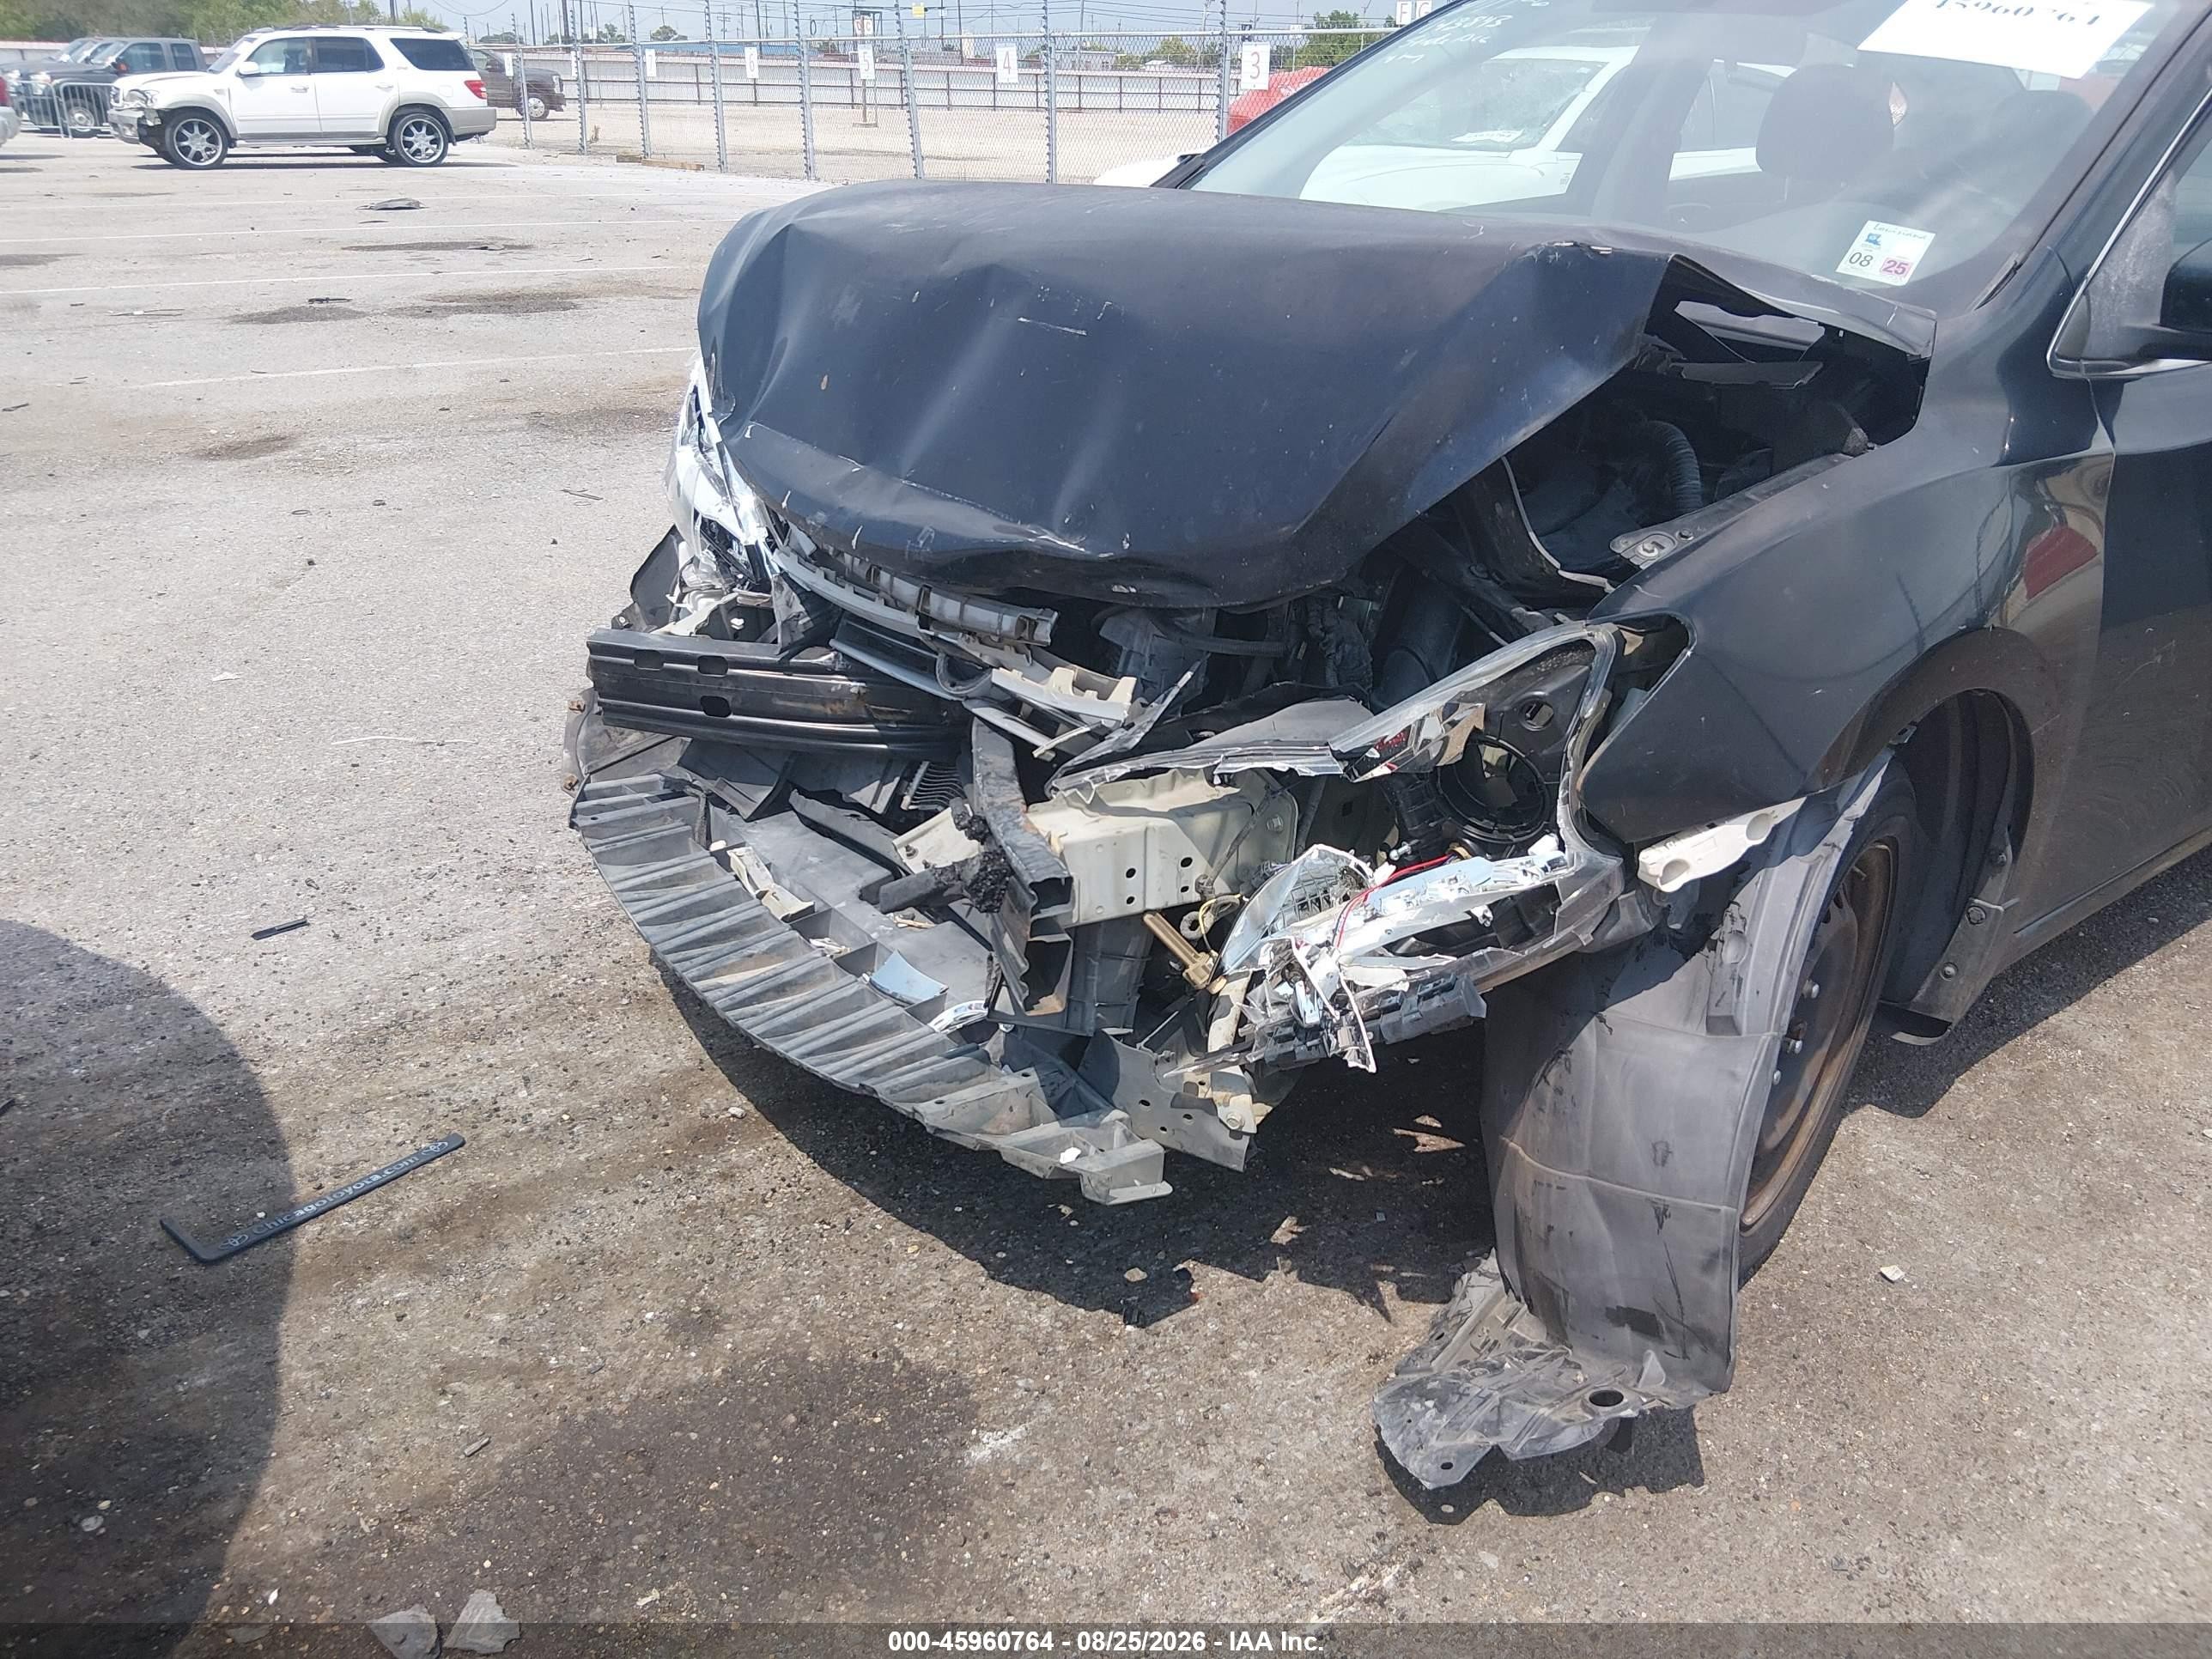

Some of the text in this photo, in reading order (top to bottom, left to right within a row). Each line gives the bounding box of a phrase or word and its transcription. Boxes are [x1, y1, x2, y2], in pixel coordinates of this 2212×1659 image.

[1399, 3, 1408, 22] F
[749, 53, 755, 72] 6
[863, 52, 870, 71] 5
[1003, 52, 1012, 75] 4
[1249, 52, 1261, 79] 3
[1849, 252, 1874, 267] 08
[1882, 259, 1909, 276] 25
